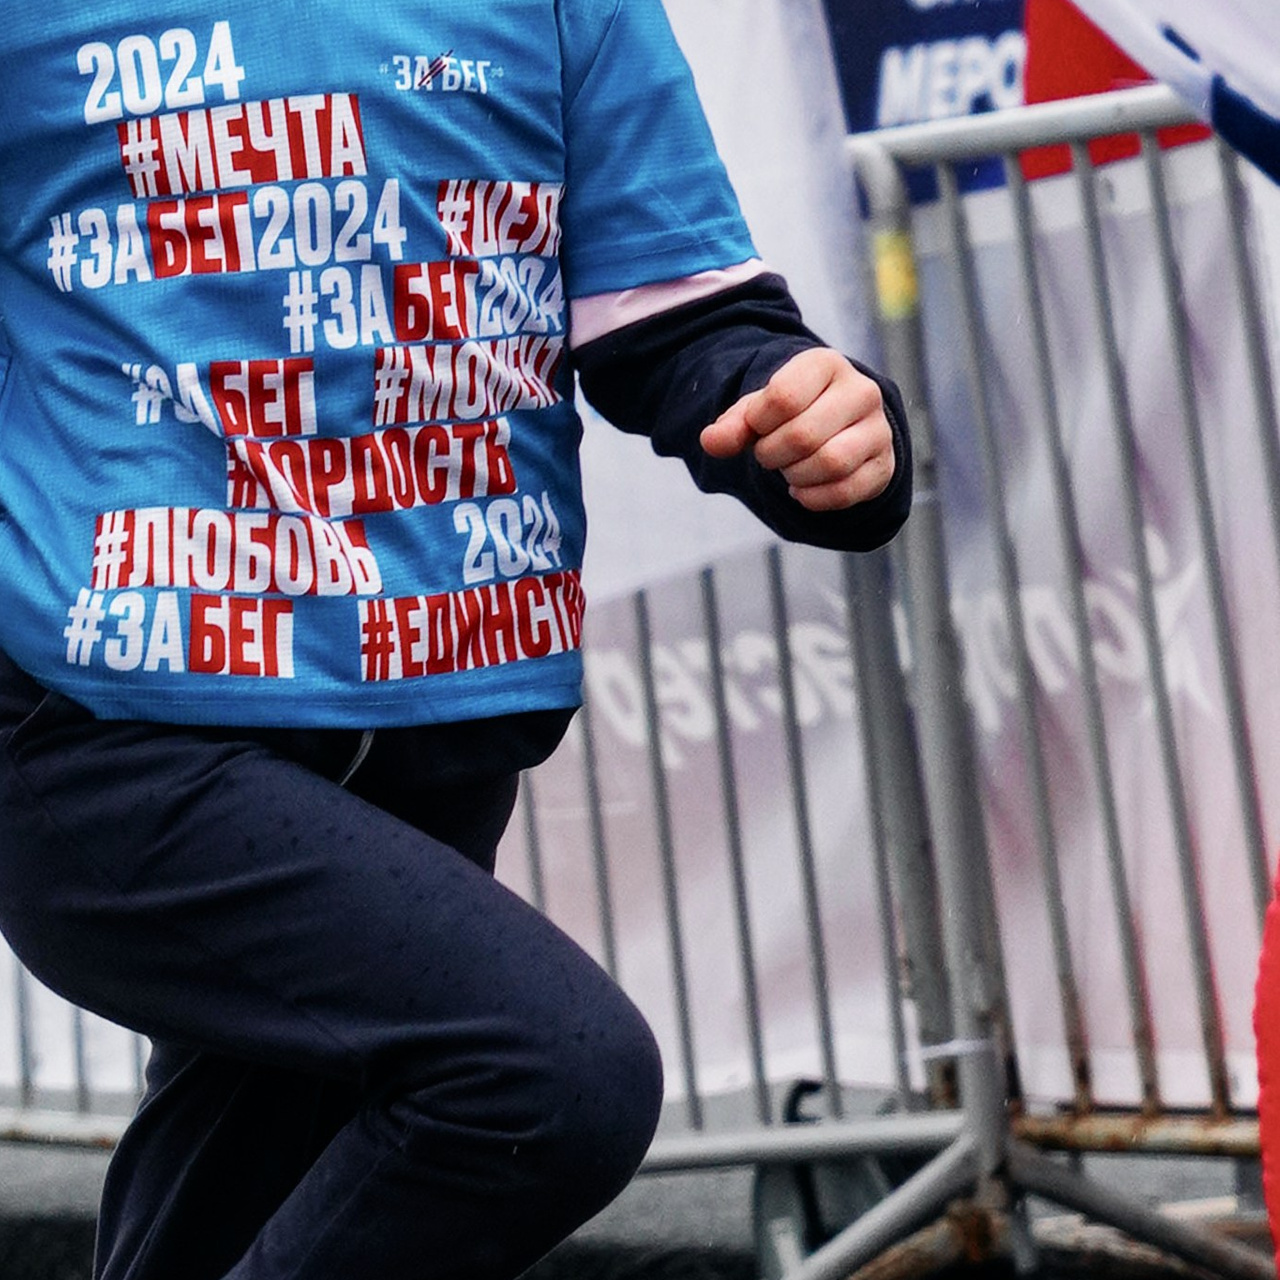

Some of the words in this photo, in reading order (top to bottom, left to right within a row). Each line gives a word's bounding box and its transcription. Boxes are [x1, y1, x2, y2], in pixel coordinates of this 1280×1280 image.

[77, 20, 245, 124] 2024
[120, 93, 368, 199] #МЕЧТА
[437, 179, 566, 257] #ЦЕЛ
[91, 506, 383, 597] #ЛЮБОВЬ
[453, 490, 561, 585] 2024
[359, 568, 586, 682] #ЕДИНСТВ
